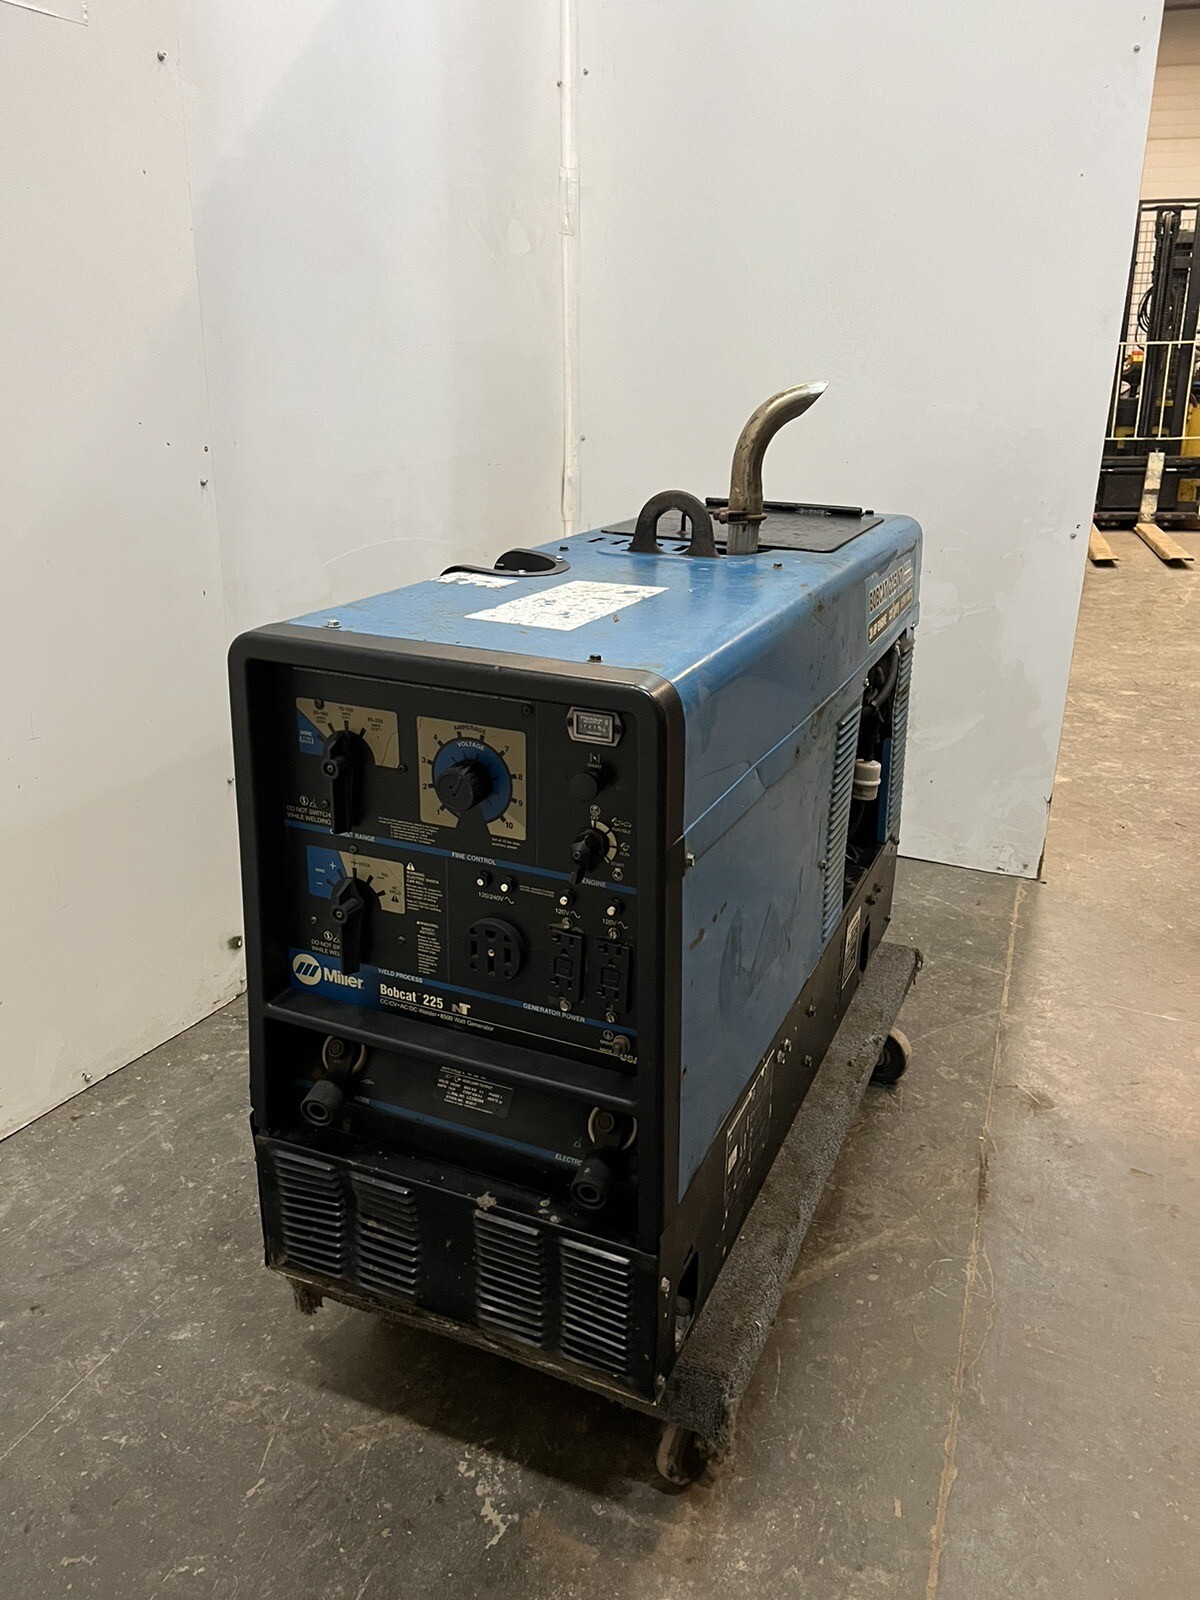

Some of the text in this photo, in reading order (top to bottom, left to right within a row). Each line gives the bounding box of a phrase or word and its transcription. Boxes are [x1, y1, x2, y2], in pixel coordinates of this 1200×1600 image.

[453, 725, 487, 736] AMPERAGE
[432, 733, 438, 741] 4
[456, 740, 485, 751] VOLTAGE
[421, 756, 427, 764] 3
[518, 773, 523, 781] 8
[422, 782, 428, 790] 2
[518, 799, 524, 807] 9
[287, 804, 332, 819] DO NOT SWITCH
[287, 811, 332, 826] WHILE WELDING
[505, 820, 514, 830] 10
[354, 832, 376, 843] RANGE
[451, 850, 497, 866] FINE CONTROL
[581, 877, 607, 889] ENGINE
[478, 891, 504, 902] 120/240V
[555, 907, 570, 916] 120V
[602, 918, 617, 926] 120V
[311, 938, 320, 946] DO
[320, 940, 332, 949] NOT
[311, 945, 329, 954] WHILE
[323, 967, 364, 989] Miller
[377, 968, 424, 984] WELD PROCESS
[379, 983, 444, 1010] Bobcat 225
[451, 1002, 471, 1015] NT
[522, 1002, 586, 1023] GENERATOR POWER
[466, 1020, 494, 1032] Generator
[554, 1153, 583, 1166] ELECTR
